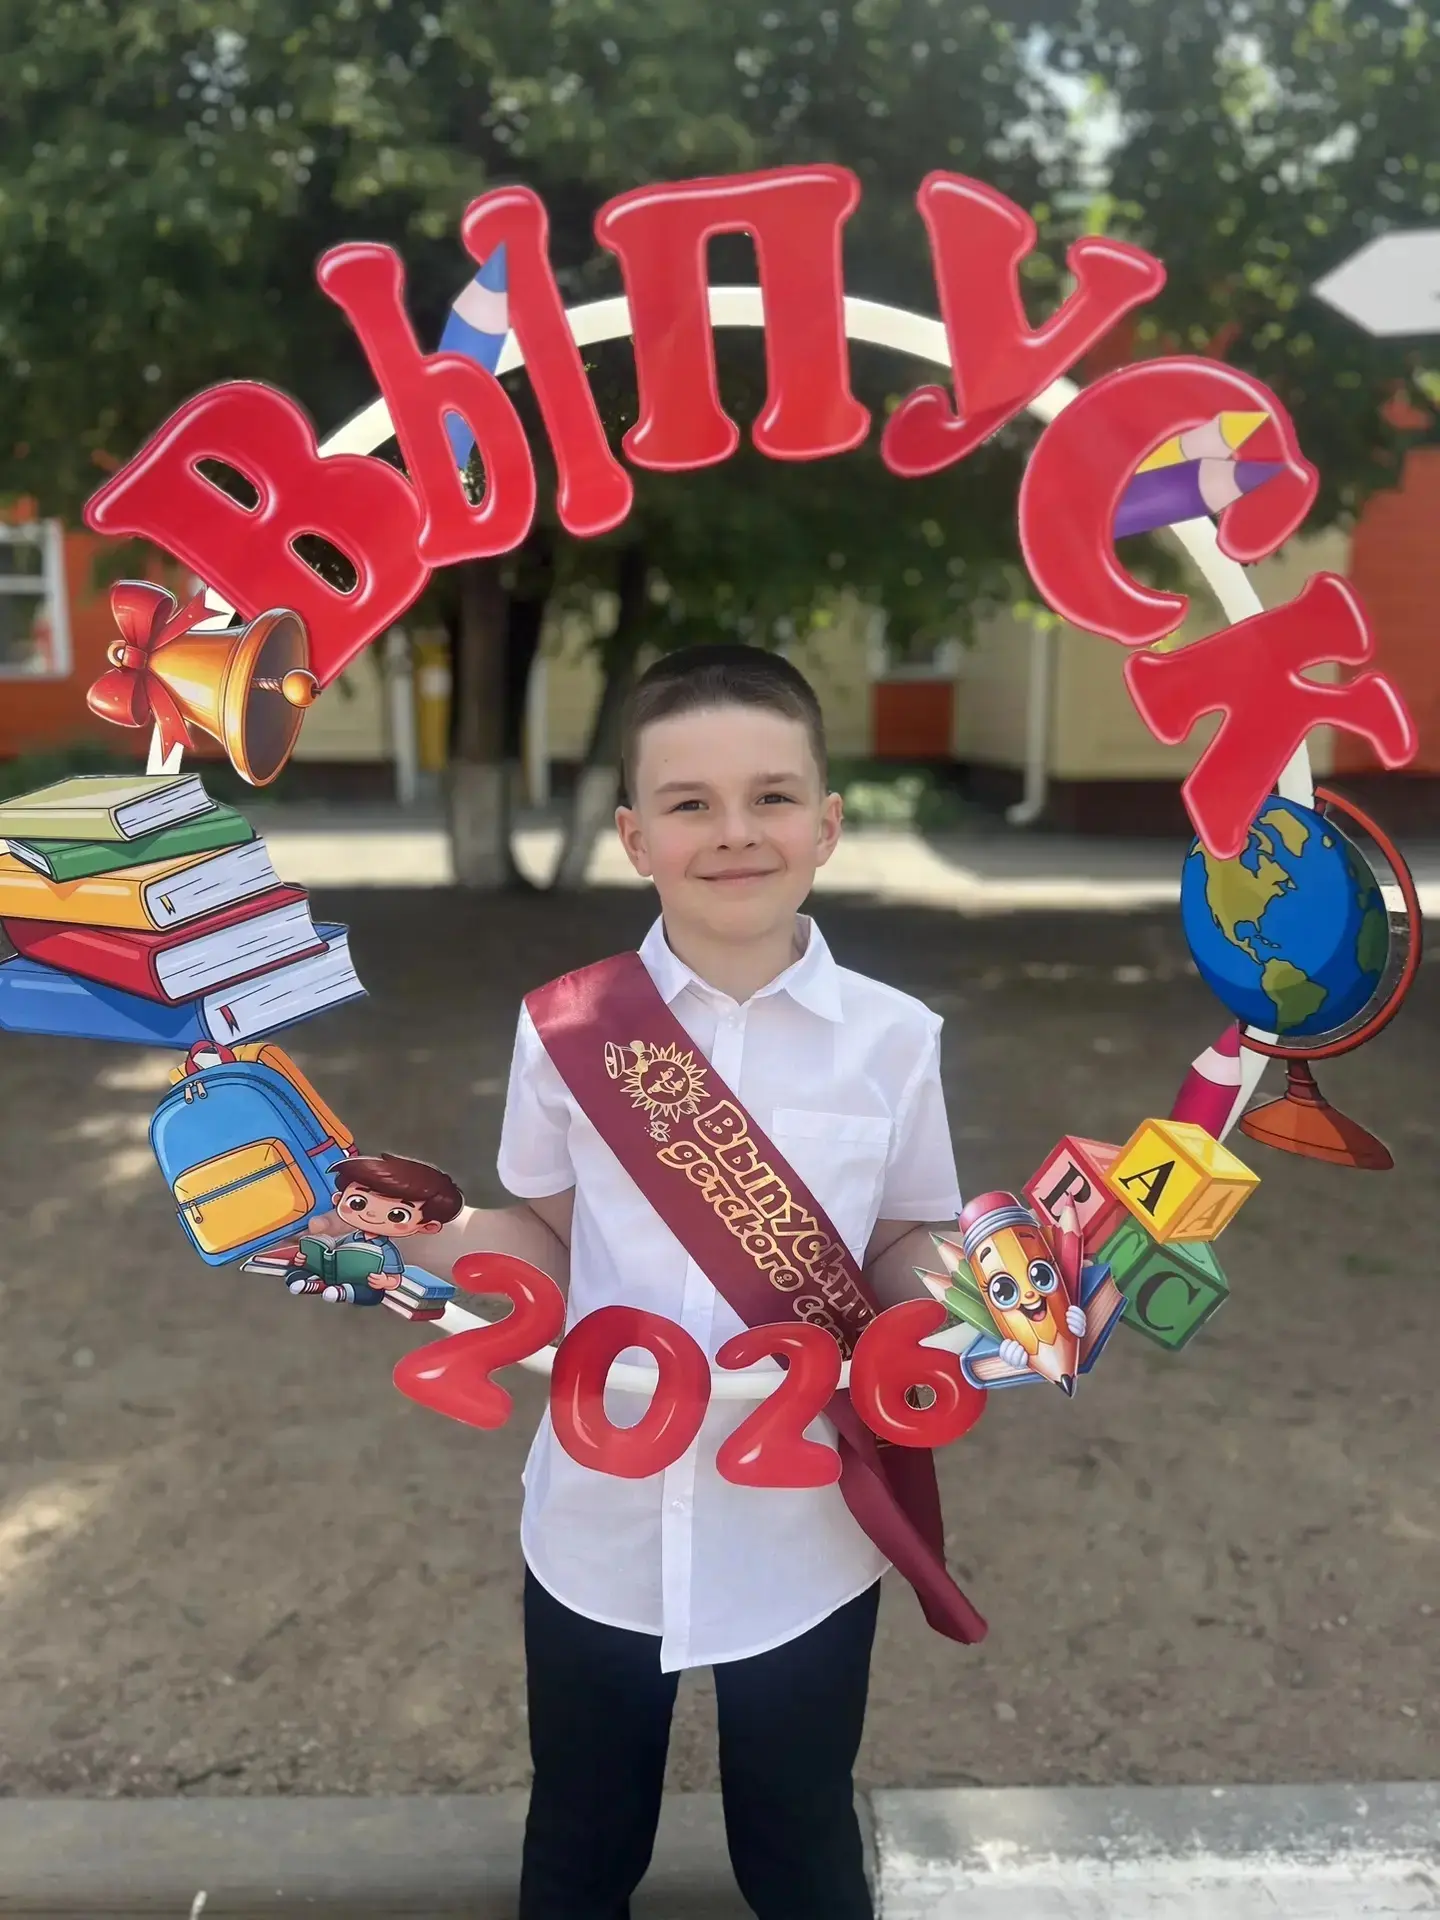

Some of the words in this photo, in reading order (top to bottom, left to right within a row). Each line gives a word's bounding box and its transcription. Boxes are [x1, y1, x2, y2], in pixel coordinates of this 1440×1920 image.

[84, 163, 1419, 860] ВЫПУСК
[656, 1141, 804, 1292] детского
[693, 1100, 877, 1332] Выпускни
[1118, 1160, 1175, 1217] A
[393, 1250, 988, 1488] 2026
[1136, 1271, 1201, 1331] C
